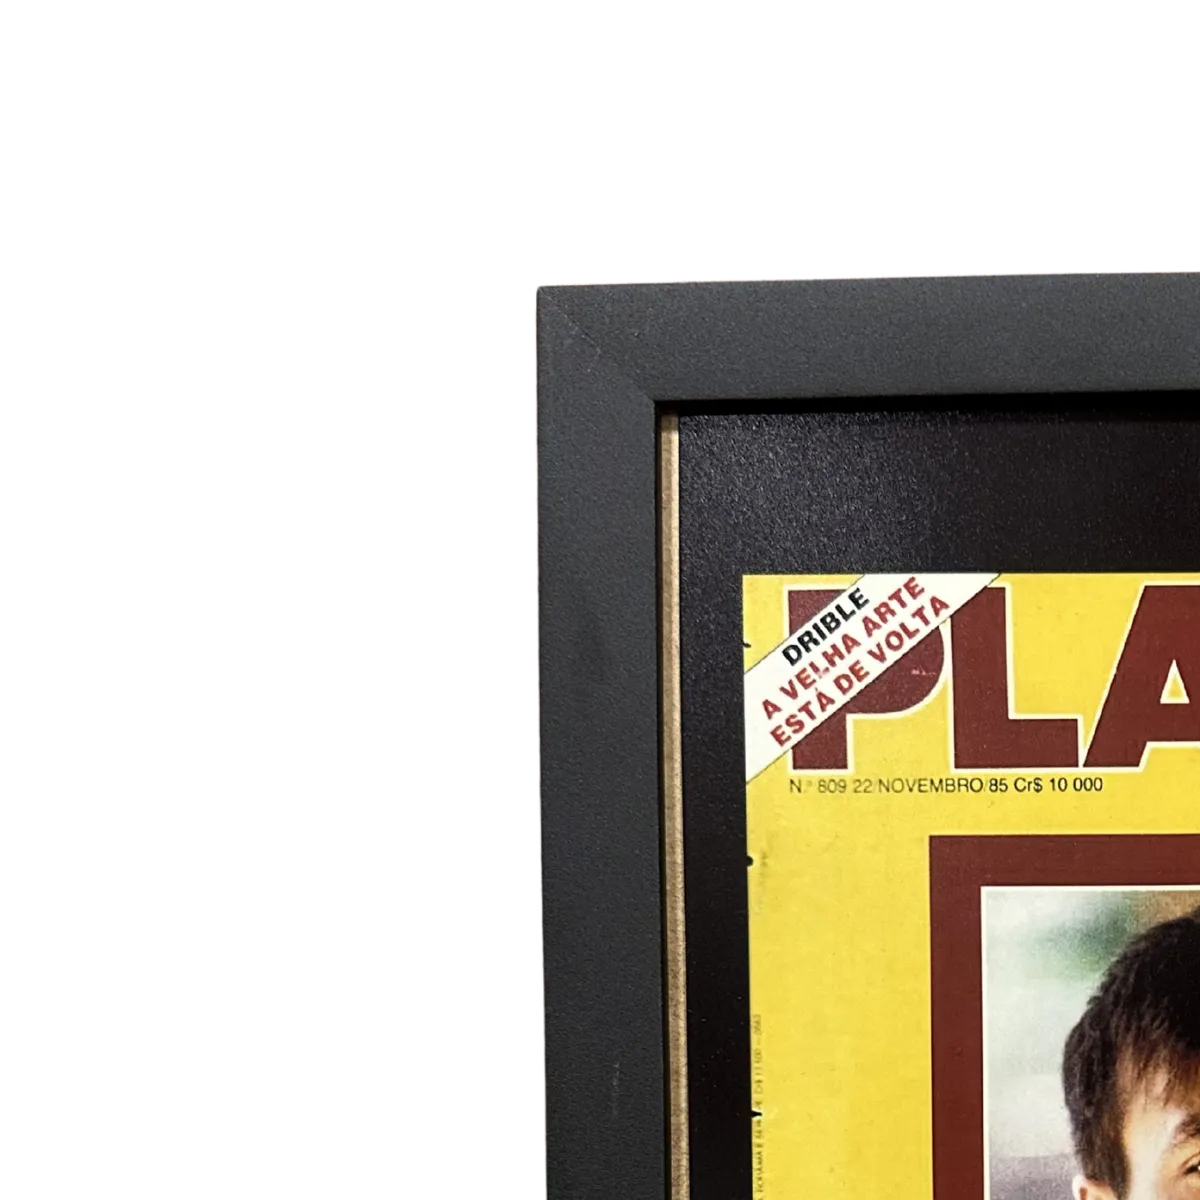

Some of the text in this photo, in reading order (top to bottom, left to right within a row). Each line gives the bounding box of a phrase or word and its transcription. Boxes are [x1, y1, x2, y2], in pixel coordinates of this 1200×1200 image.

[762, 576, 925, 720] A VELHA ARTE
[770, 595, 950, 747] ESTÁ DE VOLTA
[782, 588, 870, 666] DRIBLE
[1014, 778, 1042, 793] Cr$
[1050, 778, 1067, 792] 10
[1073, 778, 1102, 791] 000
